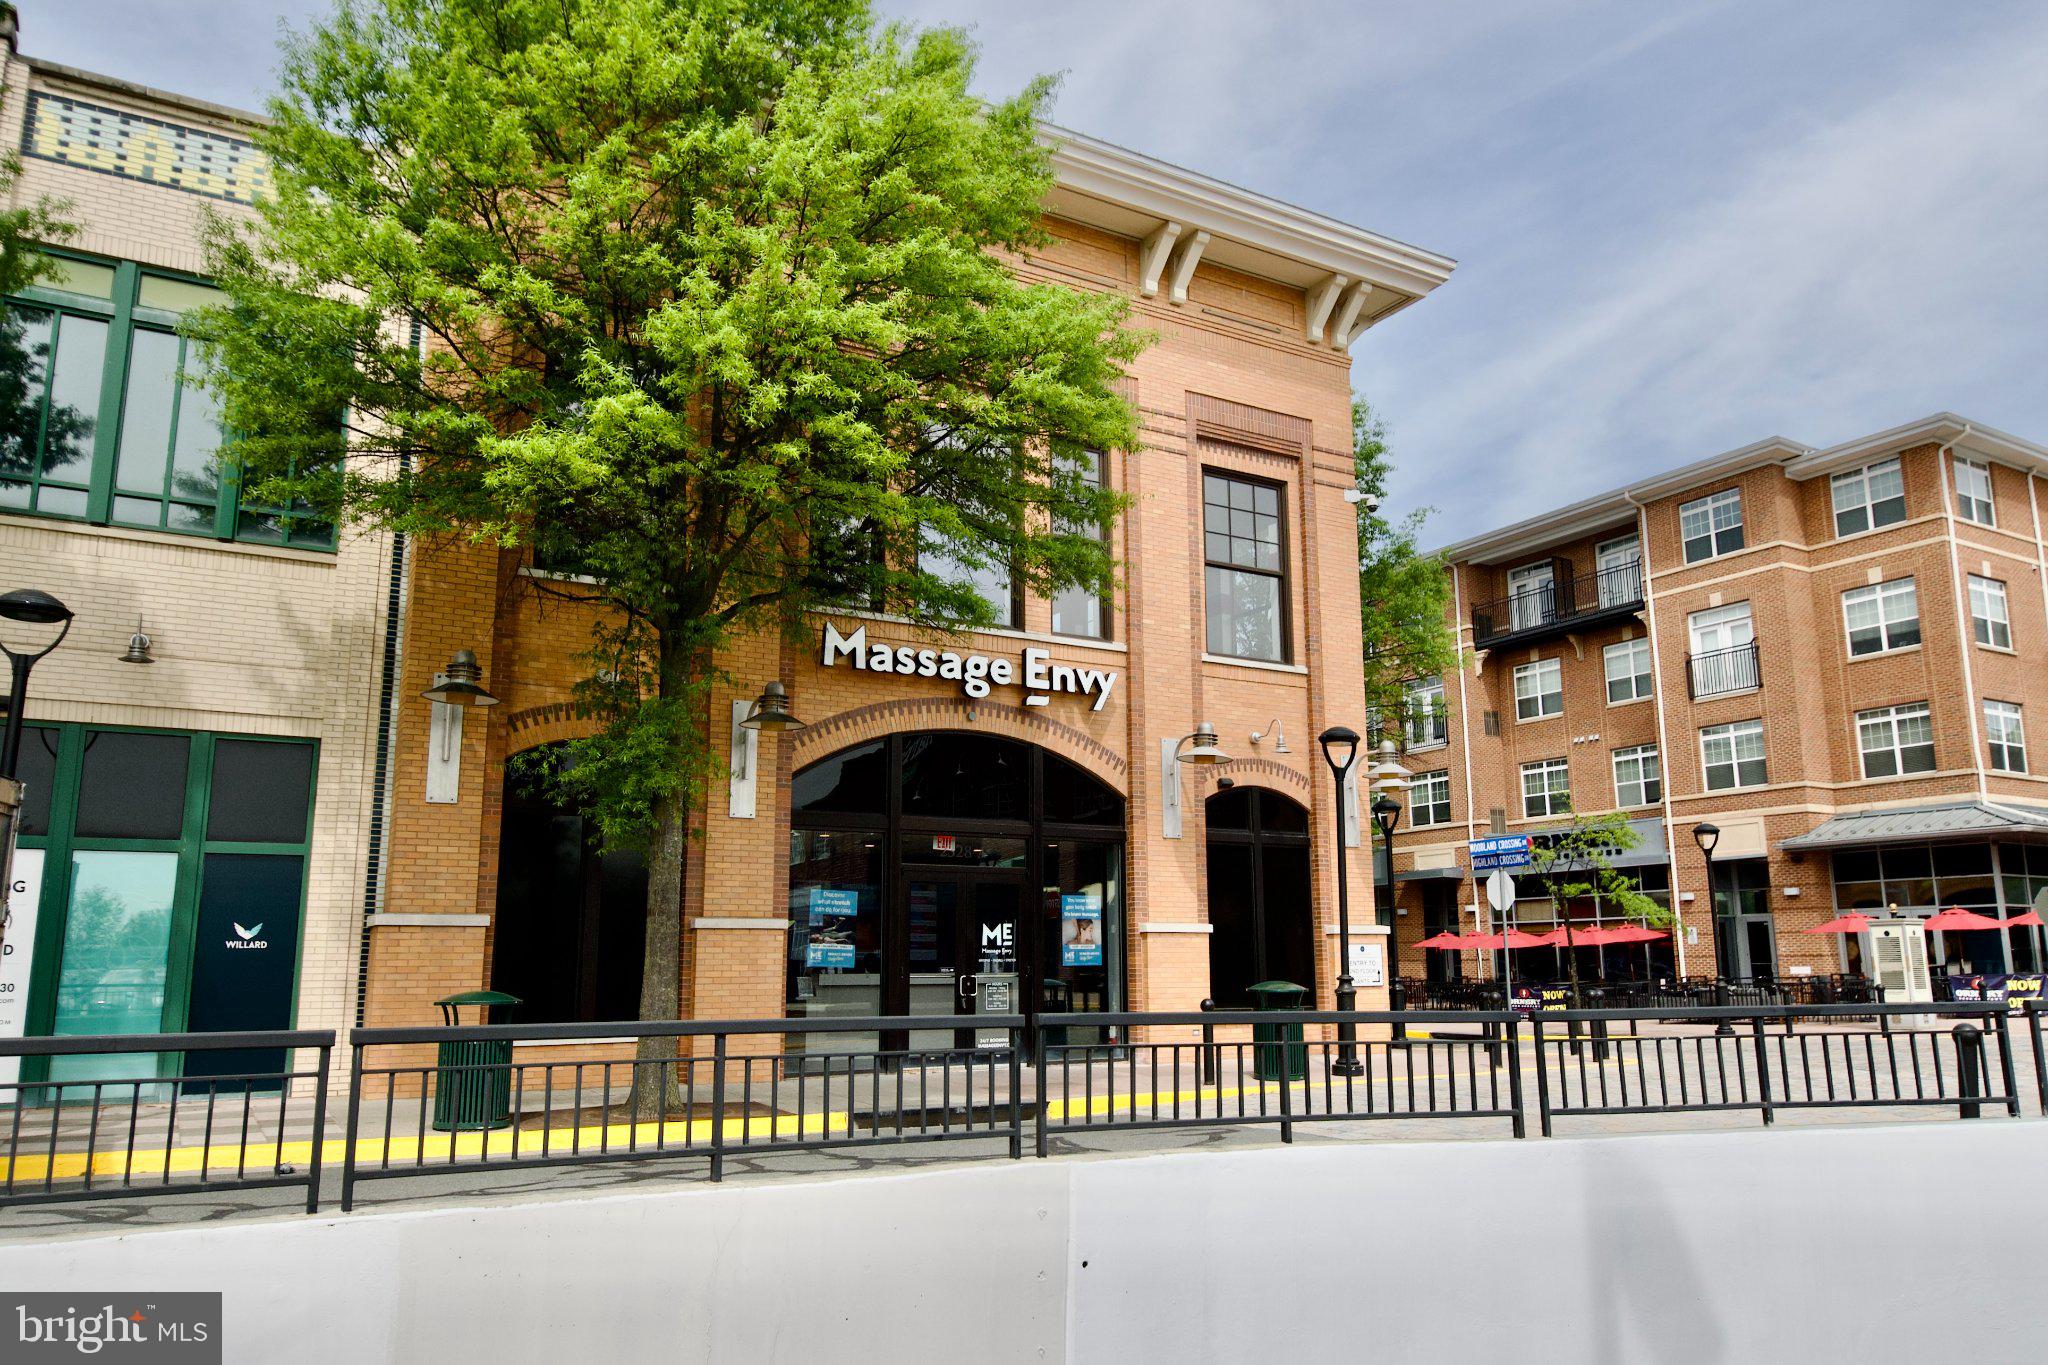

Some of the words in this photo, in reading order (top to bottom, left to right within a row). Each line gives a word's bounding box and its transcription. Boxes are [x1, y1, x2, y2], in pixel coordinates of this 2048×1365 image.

[822, 620, 1013, 698] Massage
[1022, 647, 1118, 712] Envy
[1498, 838, 1521, 849] CROSSING
[1499, 853, 1525, 865] CROSSING
[981, 923, 1013, 946] ME
[225, 940, 268, 949] WILLARD
[981, 947, 1001, 955] Massage
[1001, 947, 1012, 955] Envy
[2007, 979, 2041, 991] NOW
[1542, 990, 1566, 1000] NOW
